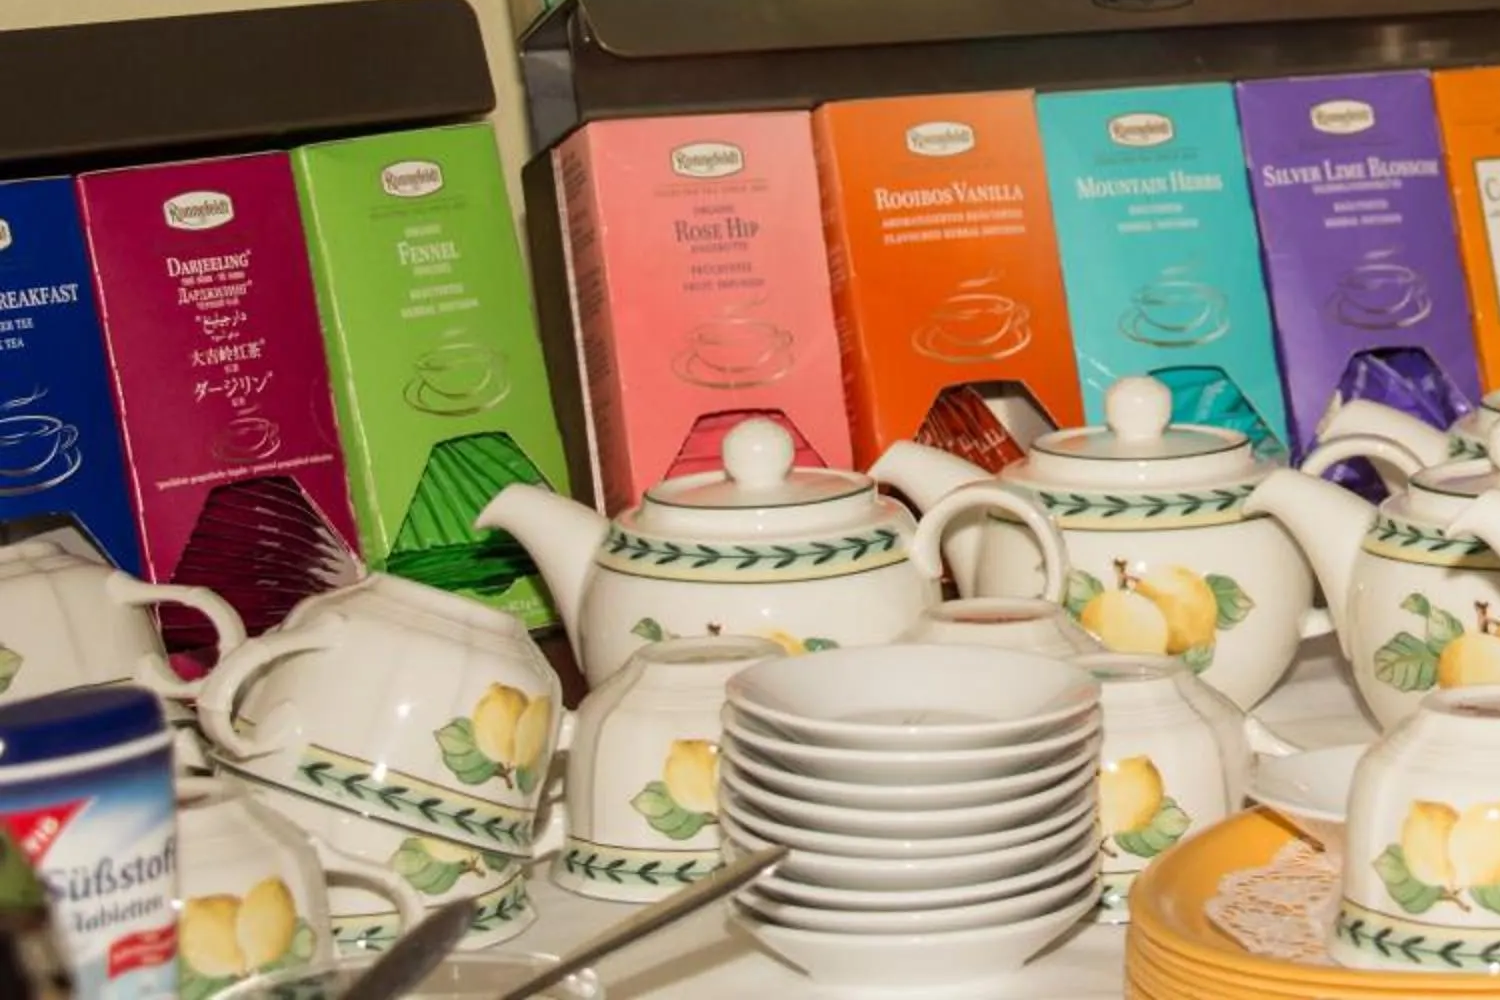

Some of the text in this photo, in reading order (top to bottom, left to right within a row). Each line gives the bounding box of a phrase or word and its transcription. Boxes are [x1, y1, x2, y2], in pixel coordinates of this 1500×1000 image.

[1076, 175, 1168, 200] MOUNTAIN
[1262, 164, 1322, 188] SILVER
[874, 181, 1024, 211] ROOIBOS VANILLA
[674, 216, 760, 243] ROSE HIP
[397, 241, 460, 265] FENNEL
[14, 317, 34, 330] TEE
